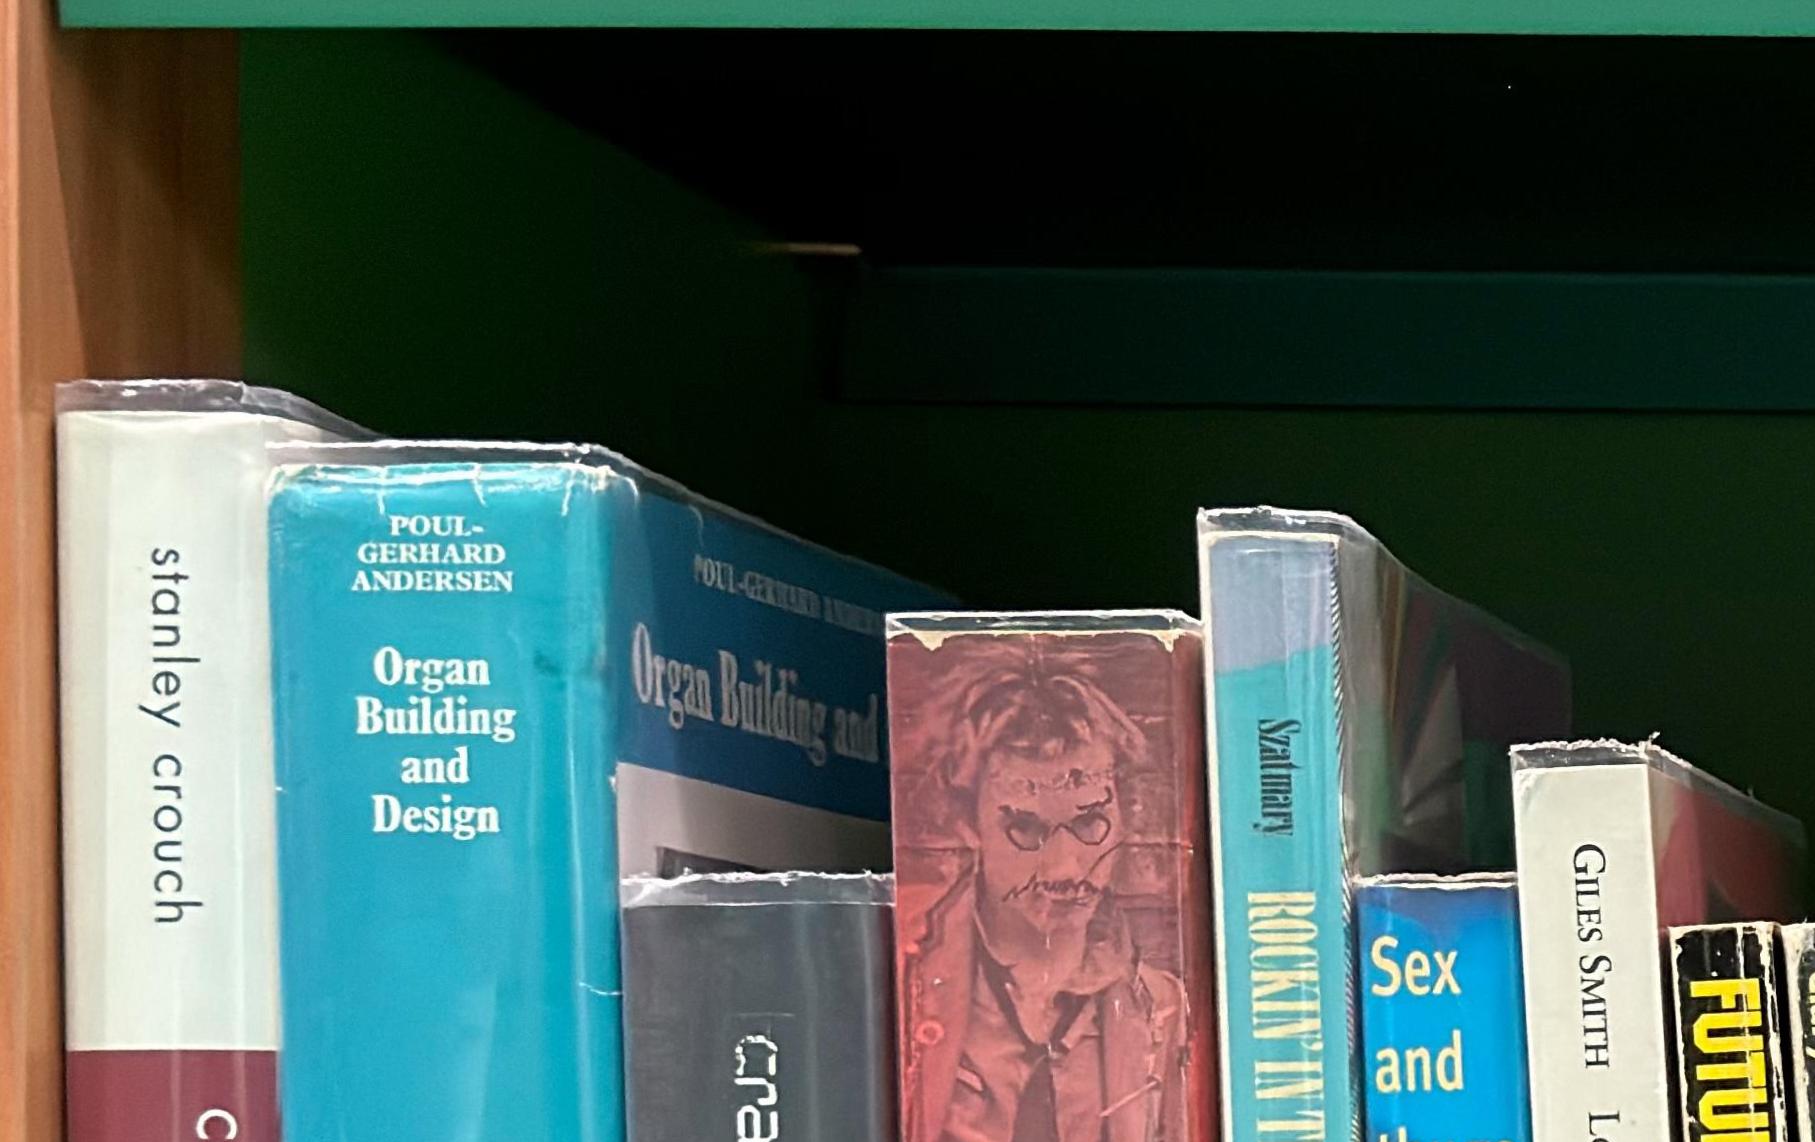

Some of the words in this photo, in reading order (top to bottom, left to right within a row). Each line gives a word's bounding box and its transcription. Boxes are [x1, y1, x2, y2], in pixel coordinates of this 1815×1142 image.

[357, 543, 506, 565] GERHARD
[389, 515, 484, 537] POUL-
[351, 571, 513, 593] ANDERSEN
[139, 548, 200, 727] stanley
[373, 647, 490, 688] Organ
[356, 697, 517, 742] Building
[631, 621, 714, 730] Organ
[718, 649, 827, 767] Building
[833, 694, 879, 763] and
[400, 747, 469, 785] and
[1253, 719, 1303, 837] Szatmary
[152, 754, 203, 924] crouch
[372, 794, 500, 836] Design
[1573, 843, 1607, 942] GILES
[1248, 892, 1323, 1050] ROCKIN'
[1371, 936, 1461, 998] Sex
[1578, 953, 1611, 1069] SMITH
[1254, 1061, 1324, 1099] IN
[1375, 1030, 1463, 1093] and
